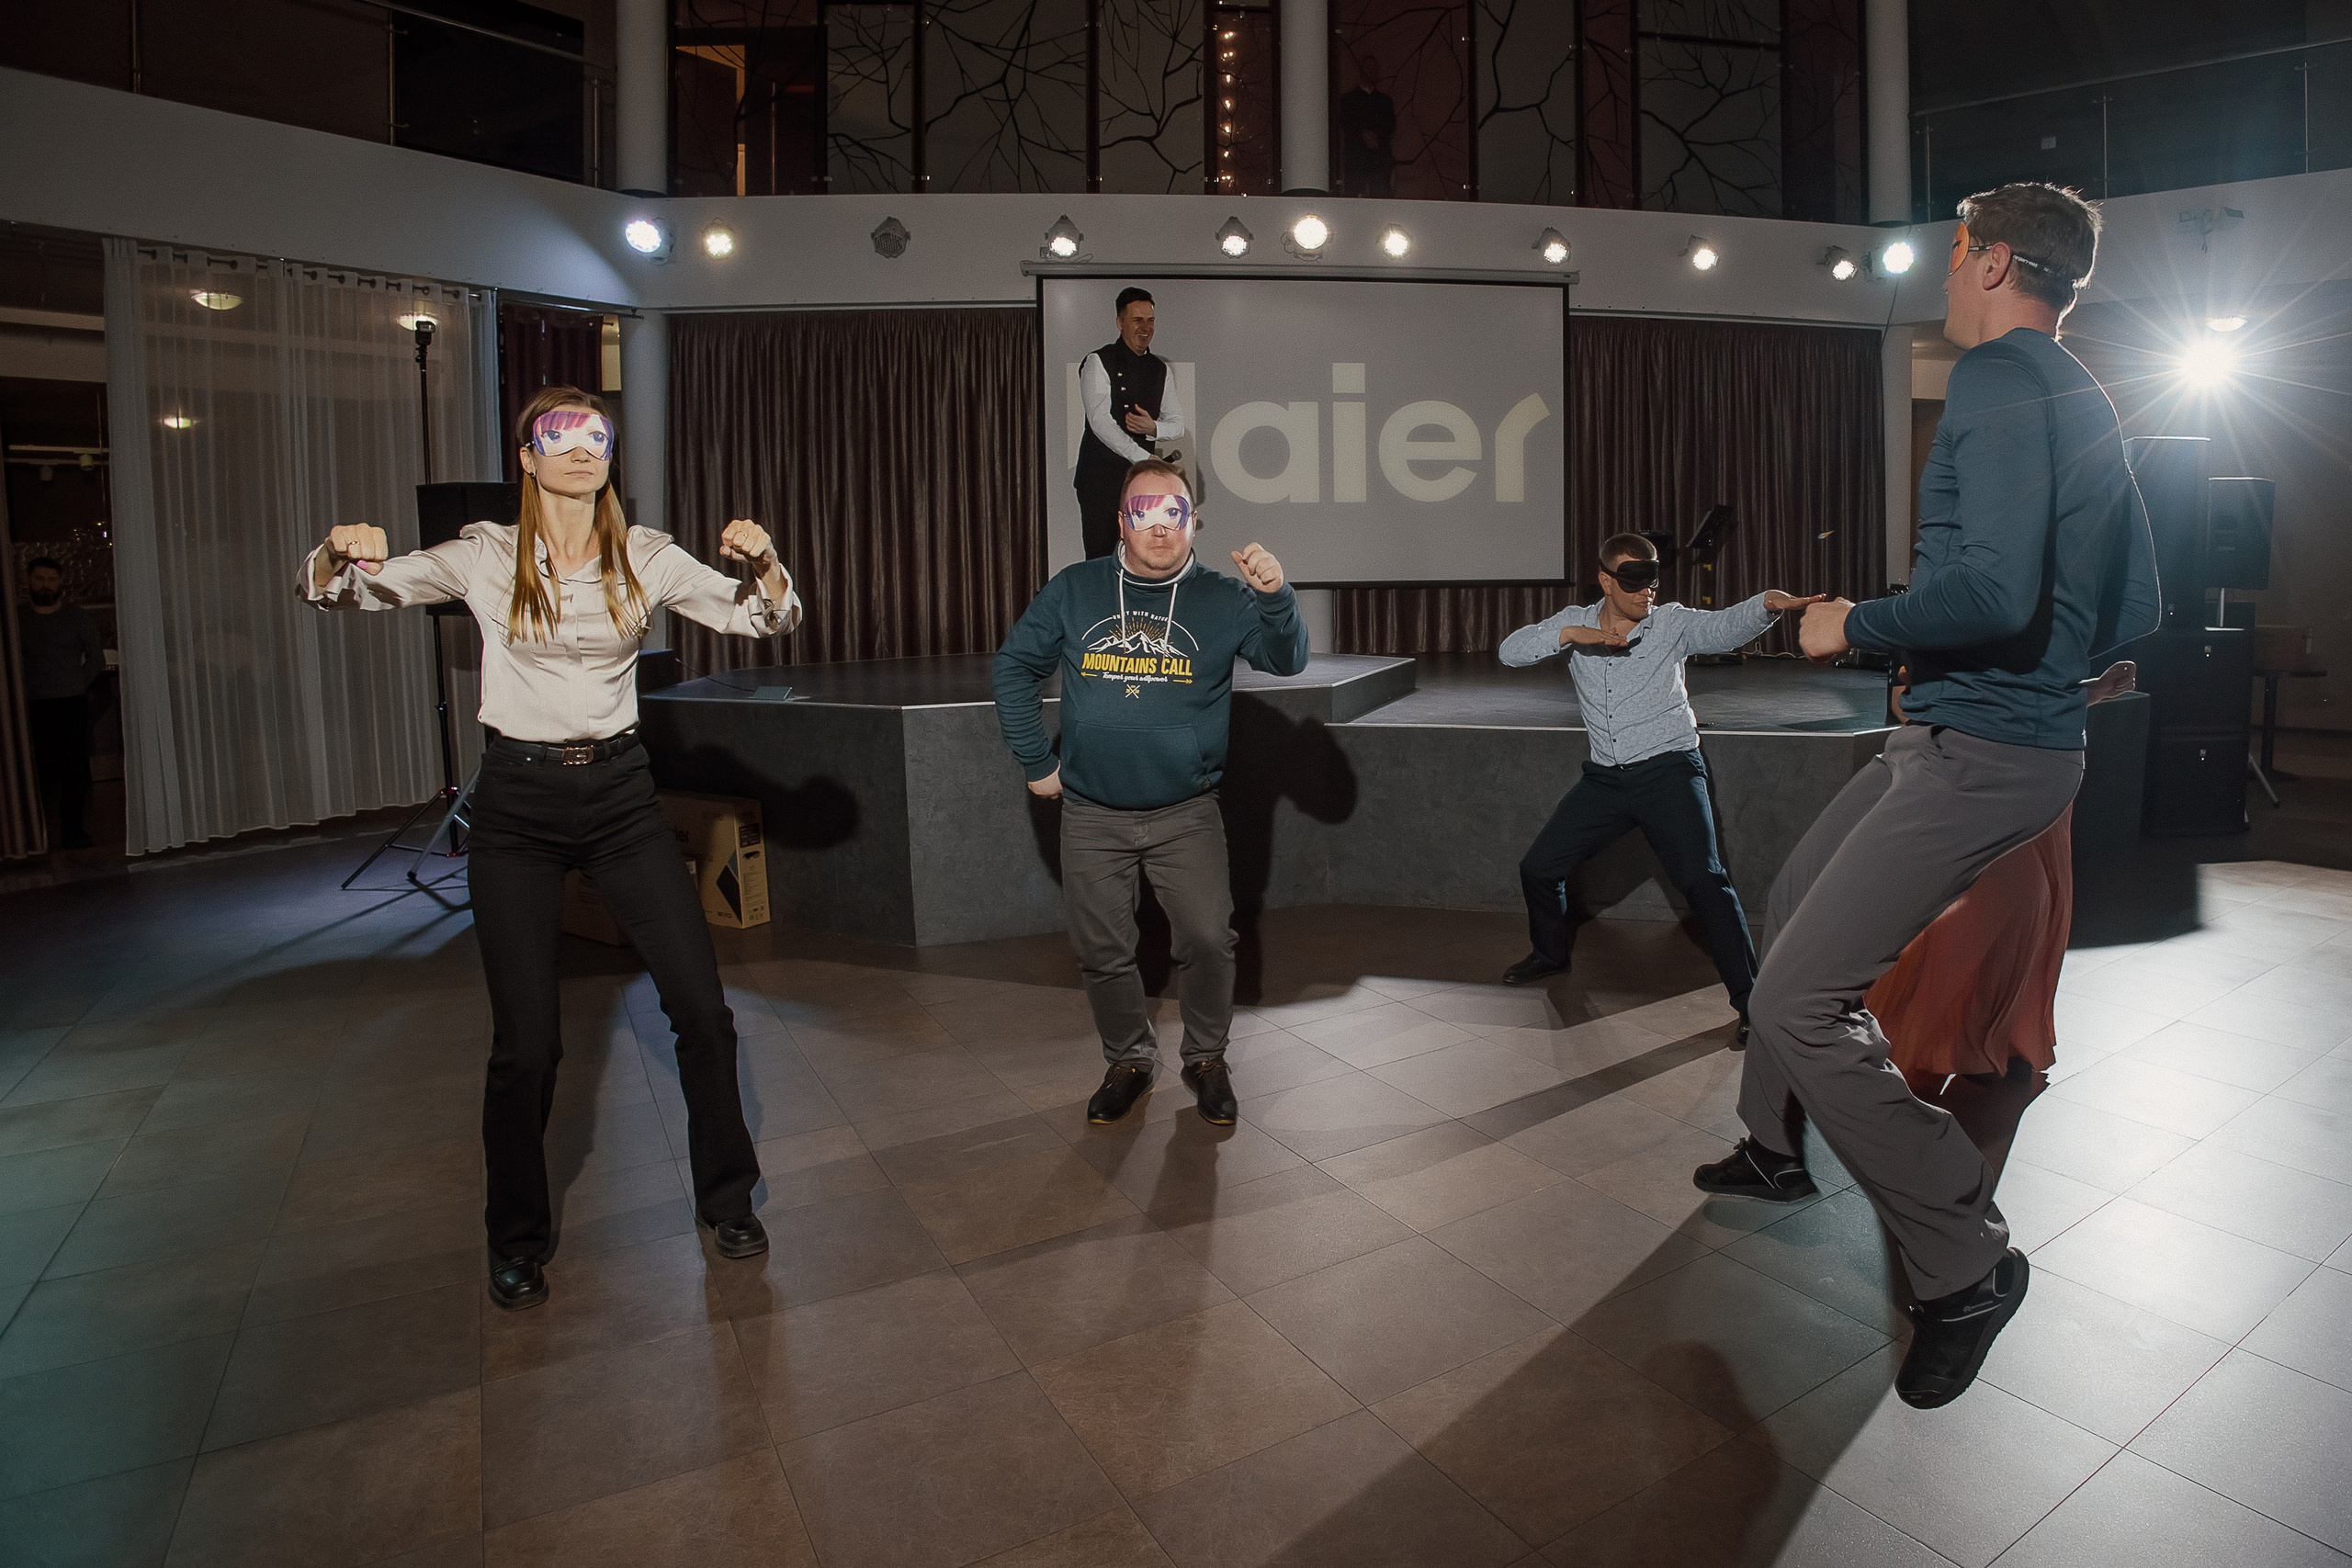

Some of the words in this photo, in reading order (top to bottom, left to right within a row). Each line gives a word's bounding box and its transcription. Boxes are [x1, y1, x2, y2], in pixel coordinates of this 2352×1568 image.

[1112, 610, 1130, 620] UNY
[1150, 614, 1170, 622] NATUR
[1081, 653, 1157, 674] MOUNTAINS
[1160, 658, 1193, 676] CALL
